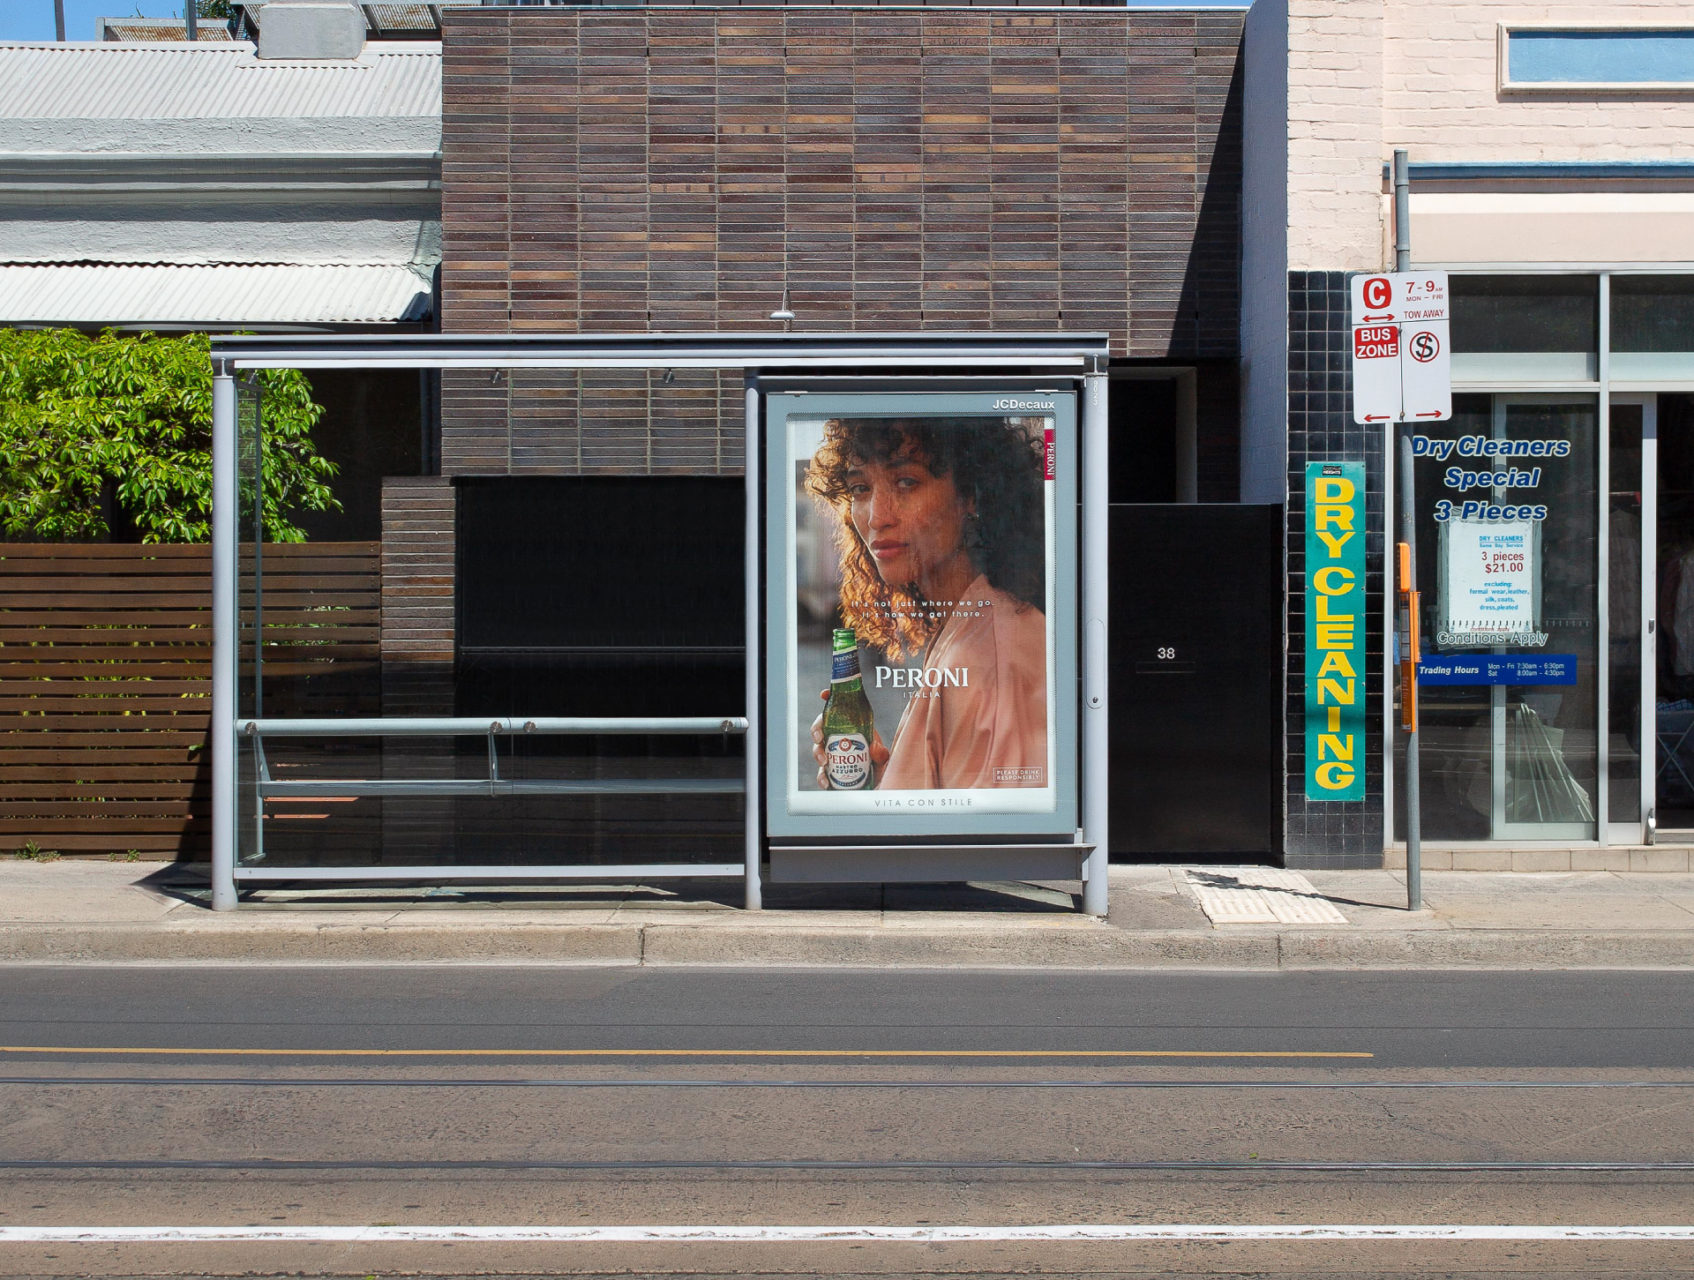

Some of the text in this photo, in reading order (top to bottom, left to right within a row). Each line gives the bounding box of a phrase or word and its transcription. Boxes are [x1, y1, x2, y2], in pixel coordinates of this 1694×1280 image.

[1368, 281, 1386, 306] C
[1403, 309, 1444, 319] TOW AWAY
[1361, 328, 1391, 342] BUS
[1357, 343, 1397, 358] ZONE
[992, 400, 1055, 410] JCDecaux
[1412, 435, 1571, 461] Dry Cleaners
[1046, 442, 1055, 476] PERONI
[1444, 467, 1541, 492] Special
[1433, 499, 1548, 522] 3 Pieces
[1314, 477, 1357, 559] DRY
[1481, 551, 1525, 563] 3 pieces
[1485, 562, 1524, 574] $21.00
[874, 600, 891, 608] not
[896, 600, 916, 609] just
[921, 600, 953, 608] where
[884, 611, 905, 619] how
[929, 611, 947, 619] get
[1437, 631, 1549, 647] Conditions Apply
[1157, 647, 1176, 660] 38
[875, 666, 968, 688] PERONI
[1419, 665, 1480, 675] Trading Hours
[1313, 566, 1358, 790] CLEANING
[827, 752, 867, 764] PERONI
[874, 798, 973, 807] VITA CON STILE
